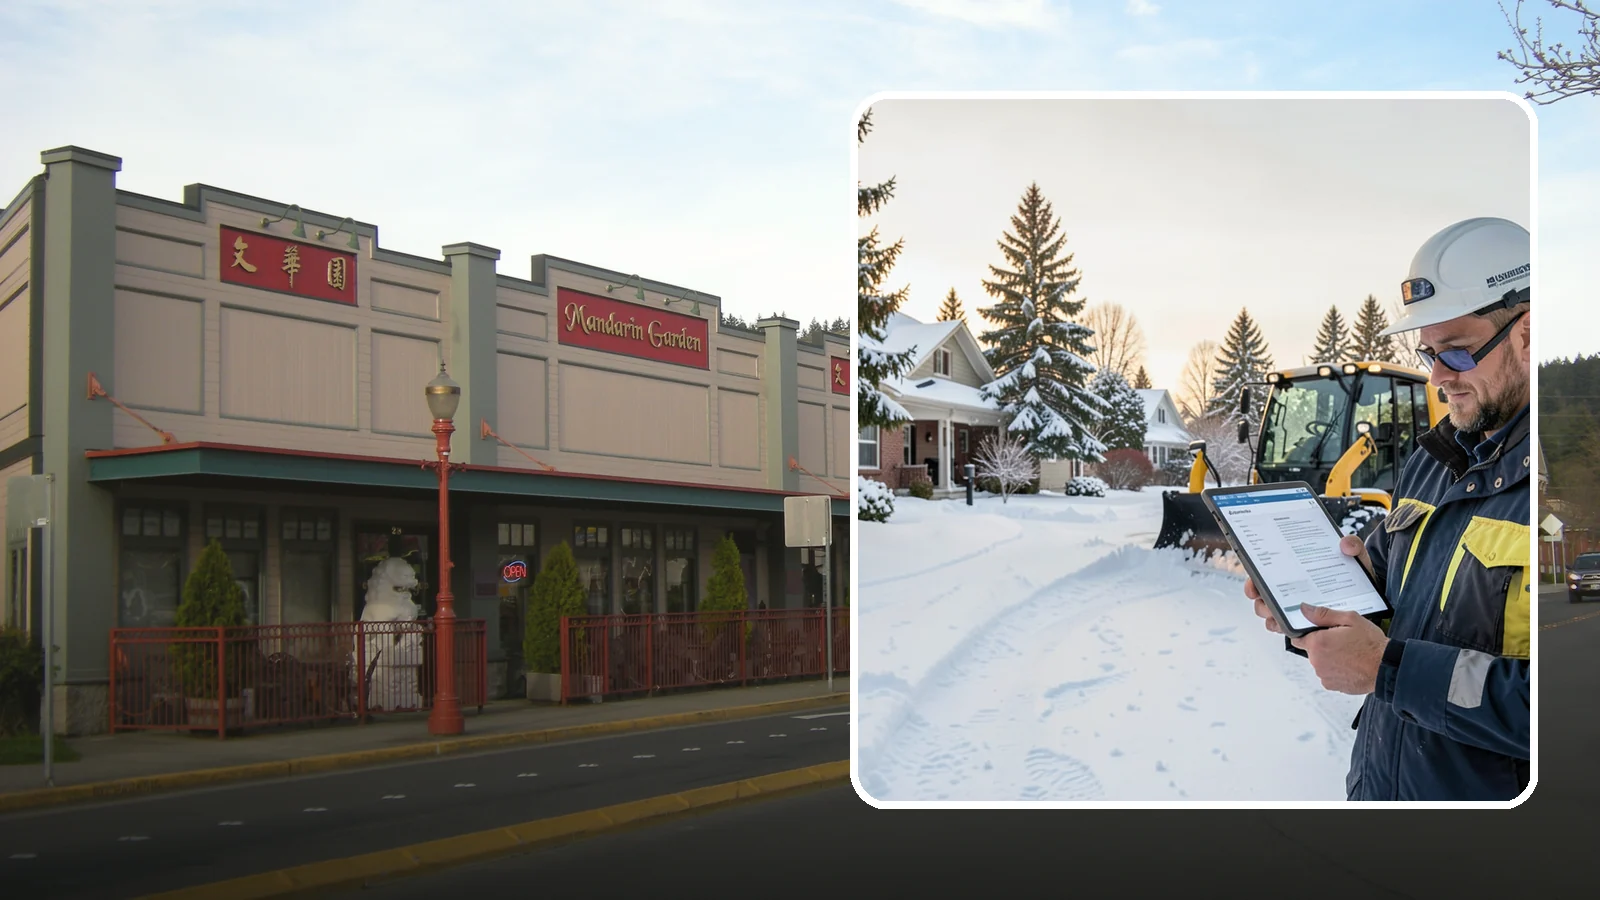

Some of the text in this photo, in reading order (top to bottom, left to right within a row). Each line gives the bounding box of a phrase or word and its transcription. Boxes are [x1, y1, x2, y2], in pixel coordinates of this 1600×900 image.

[231, 235, 346, 290] 文華園
[564, 302, 702, 352] Mandarin Garden
[503, 565, 527, 578] OPEN
